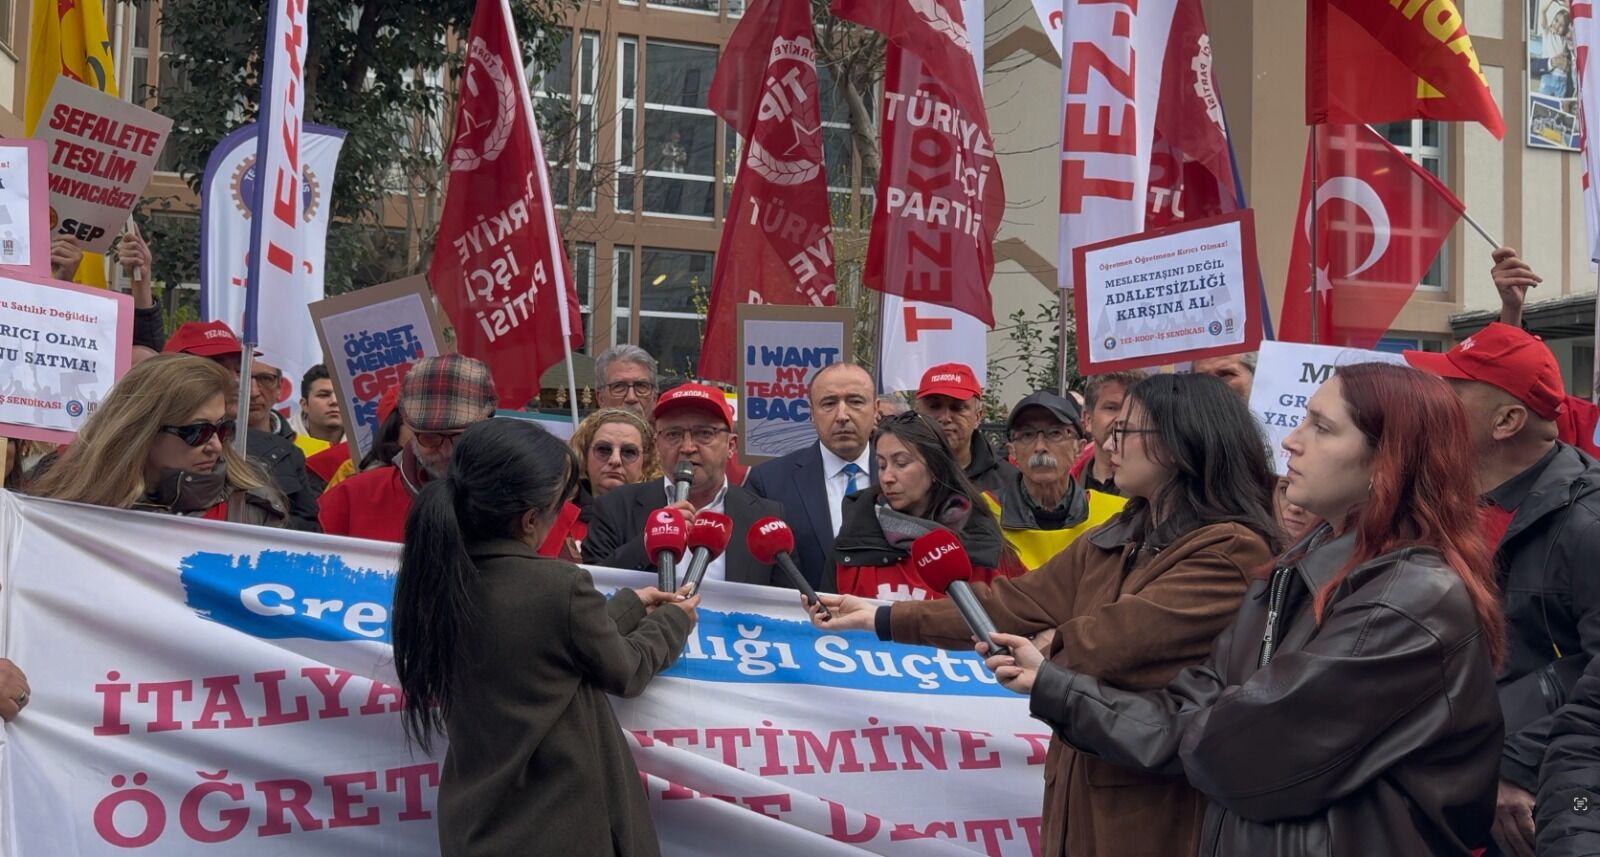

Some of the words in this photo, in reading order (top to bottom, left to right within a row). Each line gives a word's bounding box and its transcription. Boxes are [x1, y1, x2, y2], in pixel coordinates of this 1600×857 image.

[1060, 0, 1138, 214] TEZ-
[49, 103, 160, 156] SEFALETE
[51, 139, 137, 184] TESLİM
[58, 218, 105, 242] SEP
[1105, 266, 1185, 289] MESLEKTAŞINI
[1187, 259, 1225, 273] DEĞİL
[1105, 272, 1226, 306] ADALETSİZLİĞİ
[11, 301, 47, 315] Satılık
[49, 308, 98, 324] Değildir!
[1116, 300, 1184, 322] KARŞINA
[1188, 295, 1215, 310] AL!
[45, 332, 98, 350] OLMA
[24, 351, 97, 373] SATMA!
[747, 345, 756, 366] I
[761, 346, 840, 369] WANT
[776, 367, 808, 383] MY
[7, 396, 62, 409] SENDİKASI
[745, 381, 810, 399] TEACH
[746, 397, 812, 422] BAC
[651, 524, 680, 533] anka
[760, 520, 787, 535] NOW
[918, 542, 960, 567] ULUSAL
[814, 635, 1000, 690] Suçtu
[93, 667, 406, 736] İTALYA
[93, 762, 439, 848] ÖĞRET
